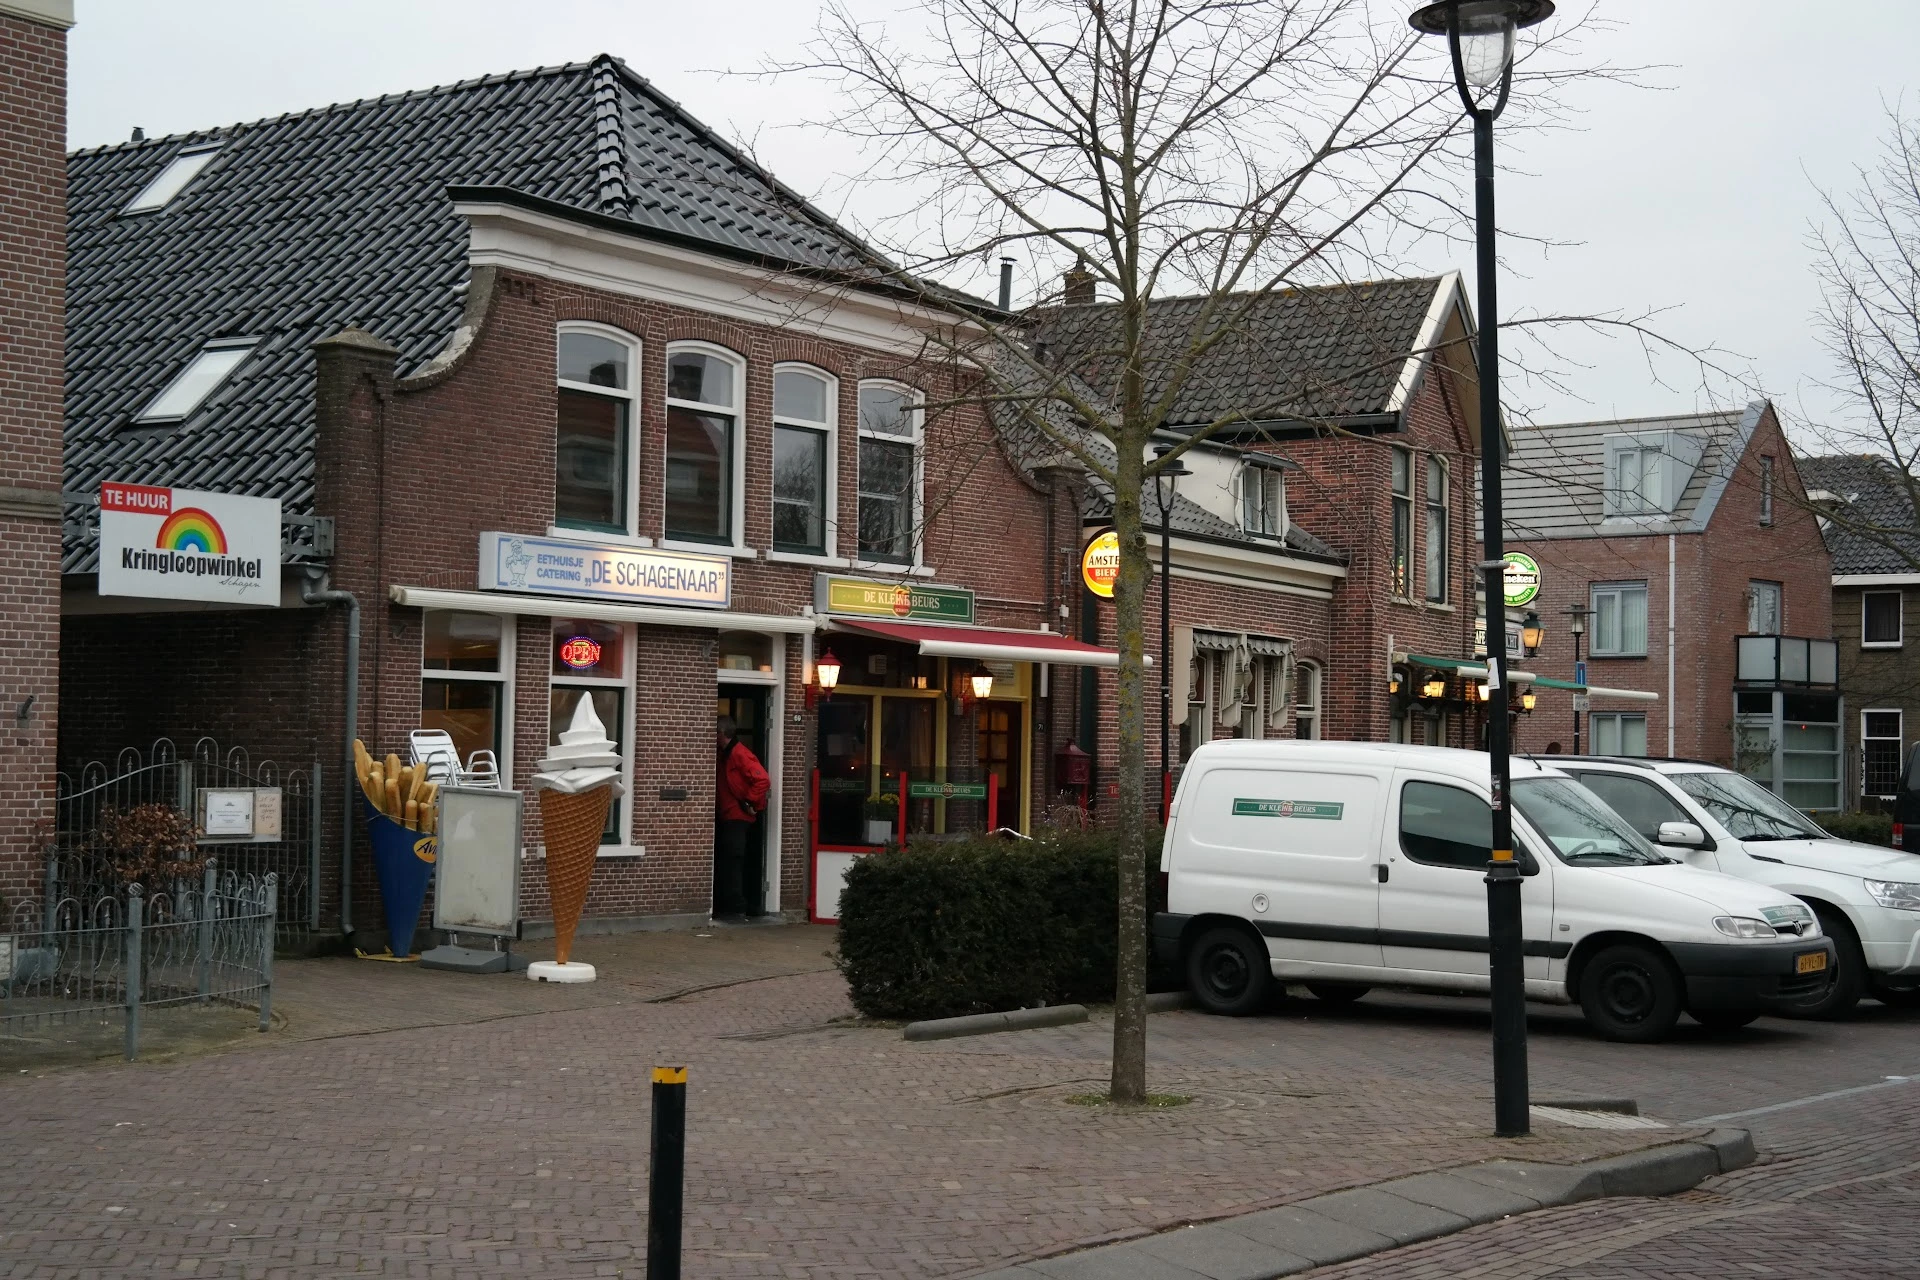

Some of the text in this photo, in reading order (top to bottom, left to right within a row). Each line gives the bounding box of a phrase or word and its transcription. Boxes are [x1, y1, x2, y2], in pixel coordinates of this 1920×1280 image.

[105, 489, 169, 510] TE HUUR
[122, 547, 261, 579] Kringloopwinkel
[537, 554, 584, 568] EETHUISJE
[1089, 555, 1120, 566] AMSTE
[536, 567, 581, 582] CATERING
[1095, 568, 1117, 577] BIER
[1503, 574, 1537, 584] ineken
[864, 590, 940, 609] DE KLEINE BEURS
[562, 644, 601, 661] OPEN
[1268, 804, 1293, 812] KLEINE
[1293, 805, 1316, 813] BEURS
